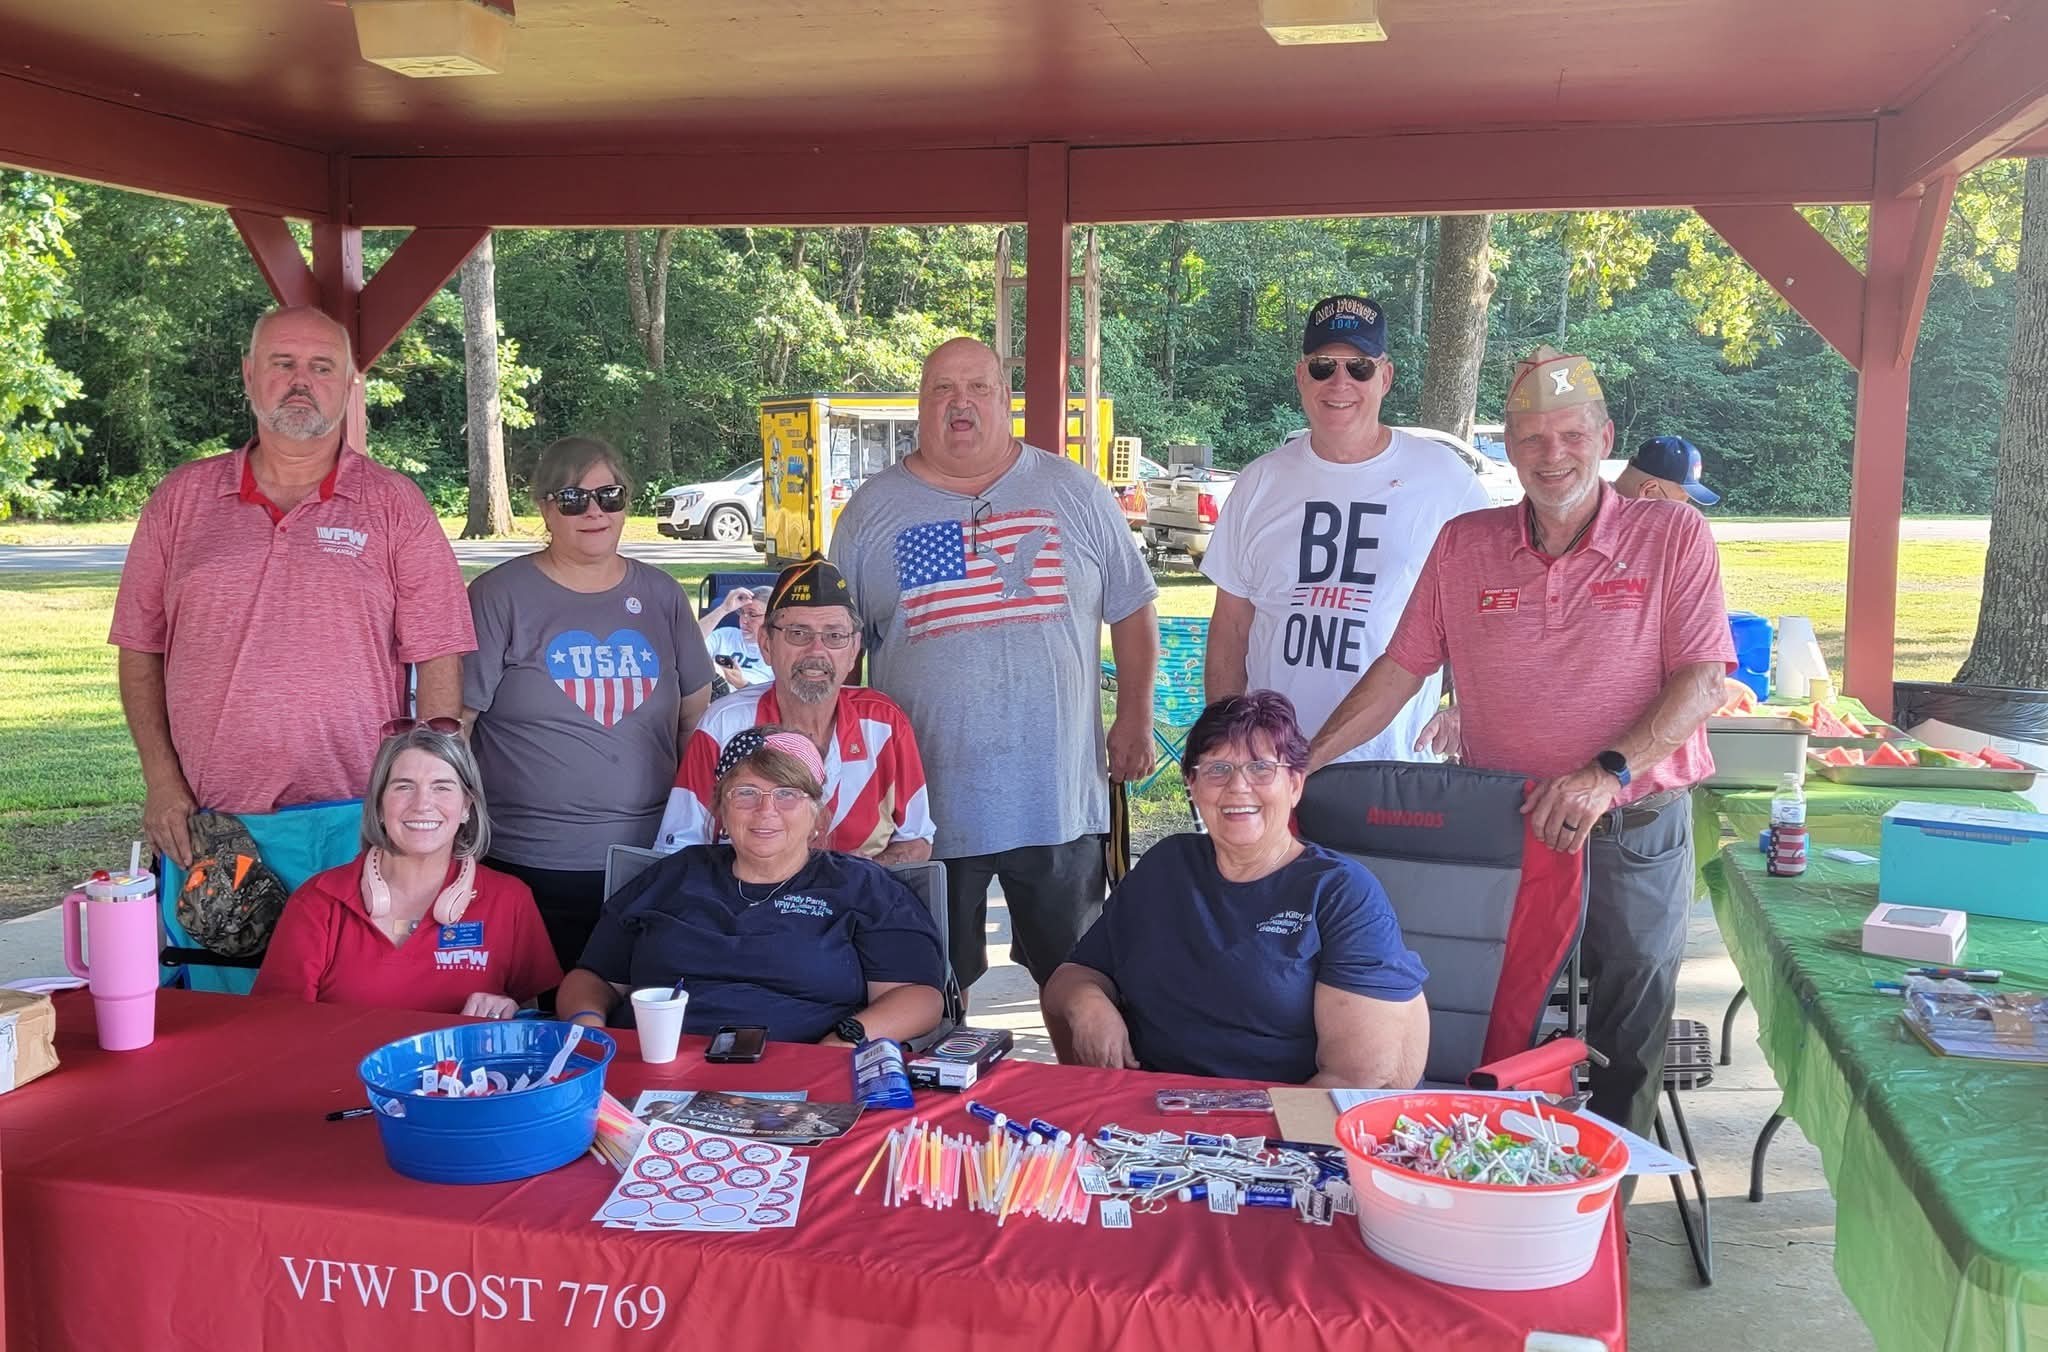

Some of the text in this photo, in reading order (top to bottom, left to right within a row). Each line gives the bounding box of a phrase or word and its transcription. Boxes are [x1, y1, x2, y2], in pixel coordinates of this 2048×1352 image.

[1315, 298, 1378, 326] AIR FORCE
[315, 527, 369, 546] VFW
[1298, 501, 1387, 585] BE
[793, 584, 810, 593] VFW
[1589, 578, 1648, 594] VFW
[1310, 586, 1355, 610] THE
[1283, 612, 1366, 673] ONE
[568, 645, 642, 677] USA
[774, 900, 791, 909] VFW
[783, 895, 805, 904] Cindy
[1285, 910, 1305, 920] Kilby
[433, 949, 489, 966] VFW
[675, 1117, 692, 1126] NO
[280, 1256, 667, 1330] VFW POST 7769
